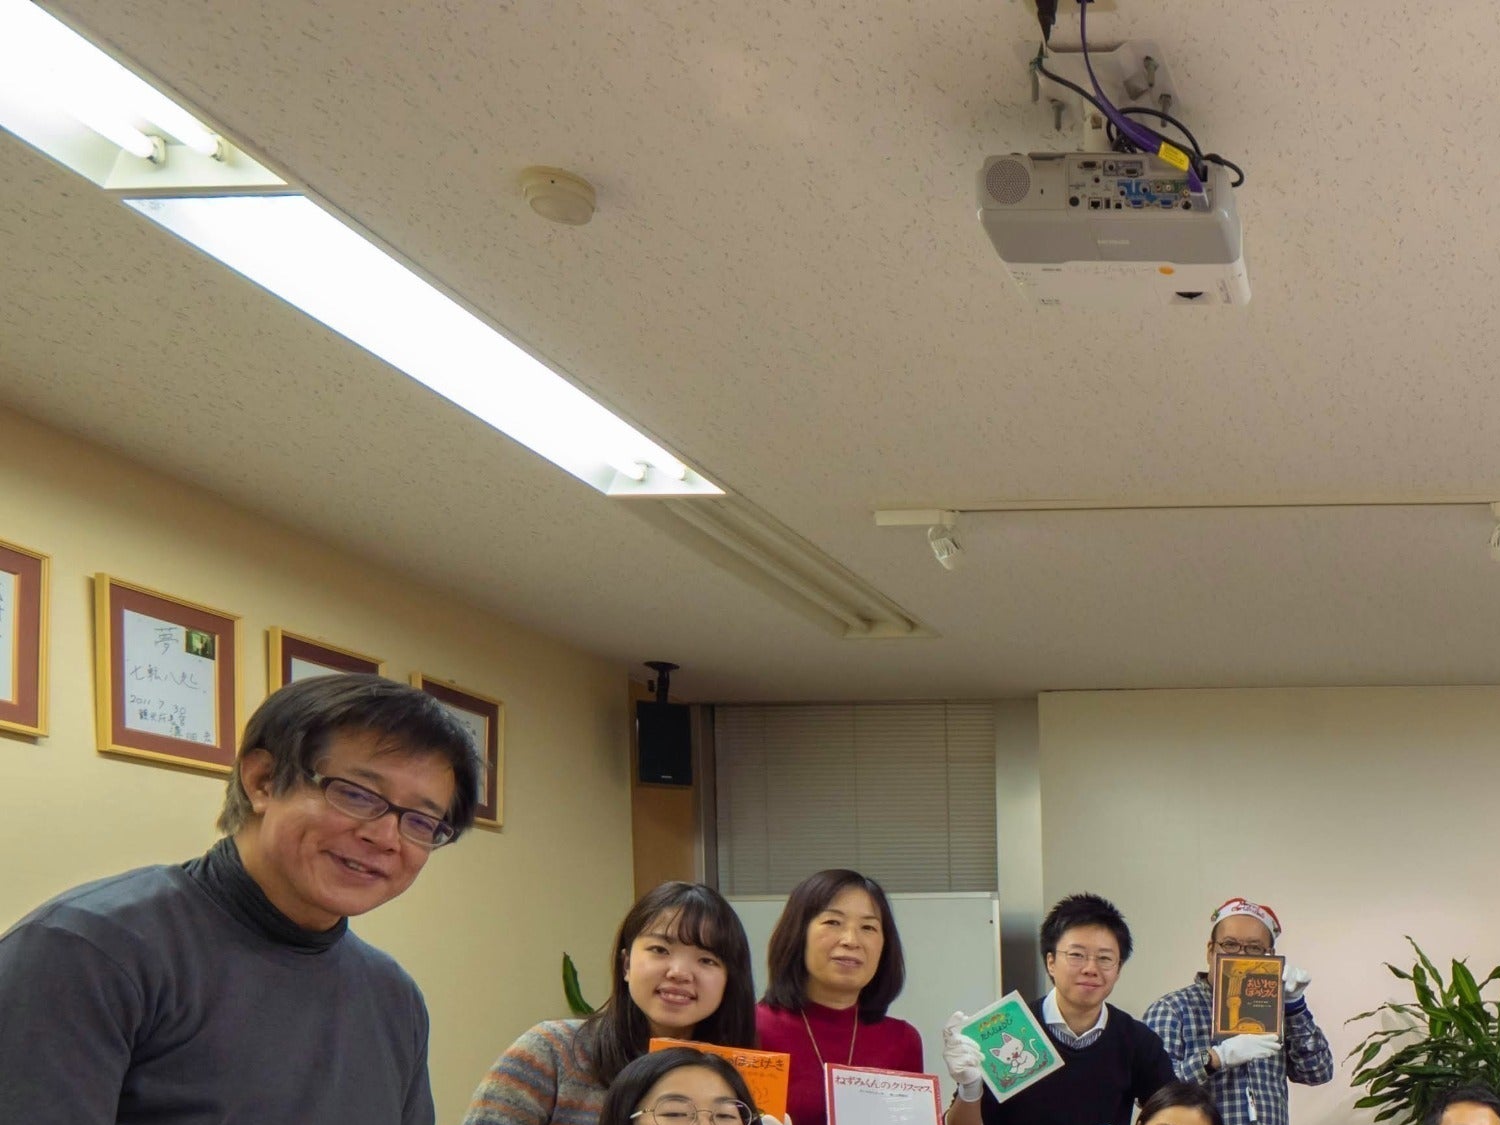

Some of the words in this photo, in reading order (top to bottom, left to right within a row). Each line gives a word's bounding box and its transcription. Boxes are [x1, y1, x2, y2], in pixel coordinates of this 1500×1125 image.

[835, 1075, 932, 1093] ねずみくんのクリスマス
